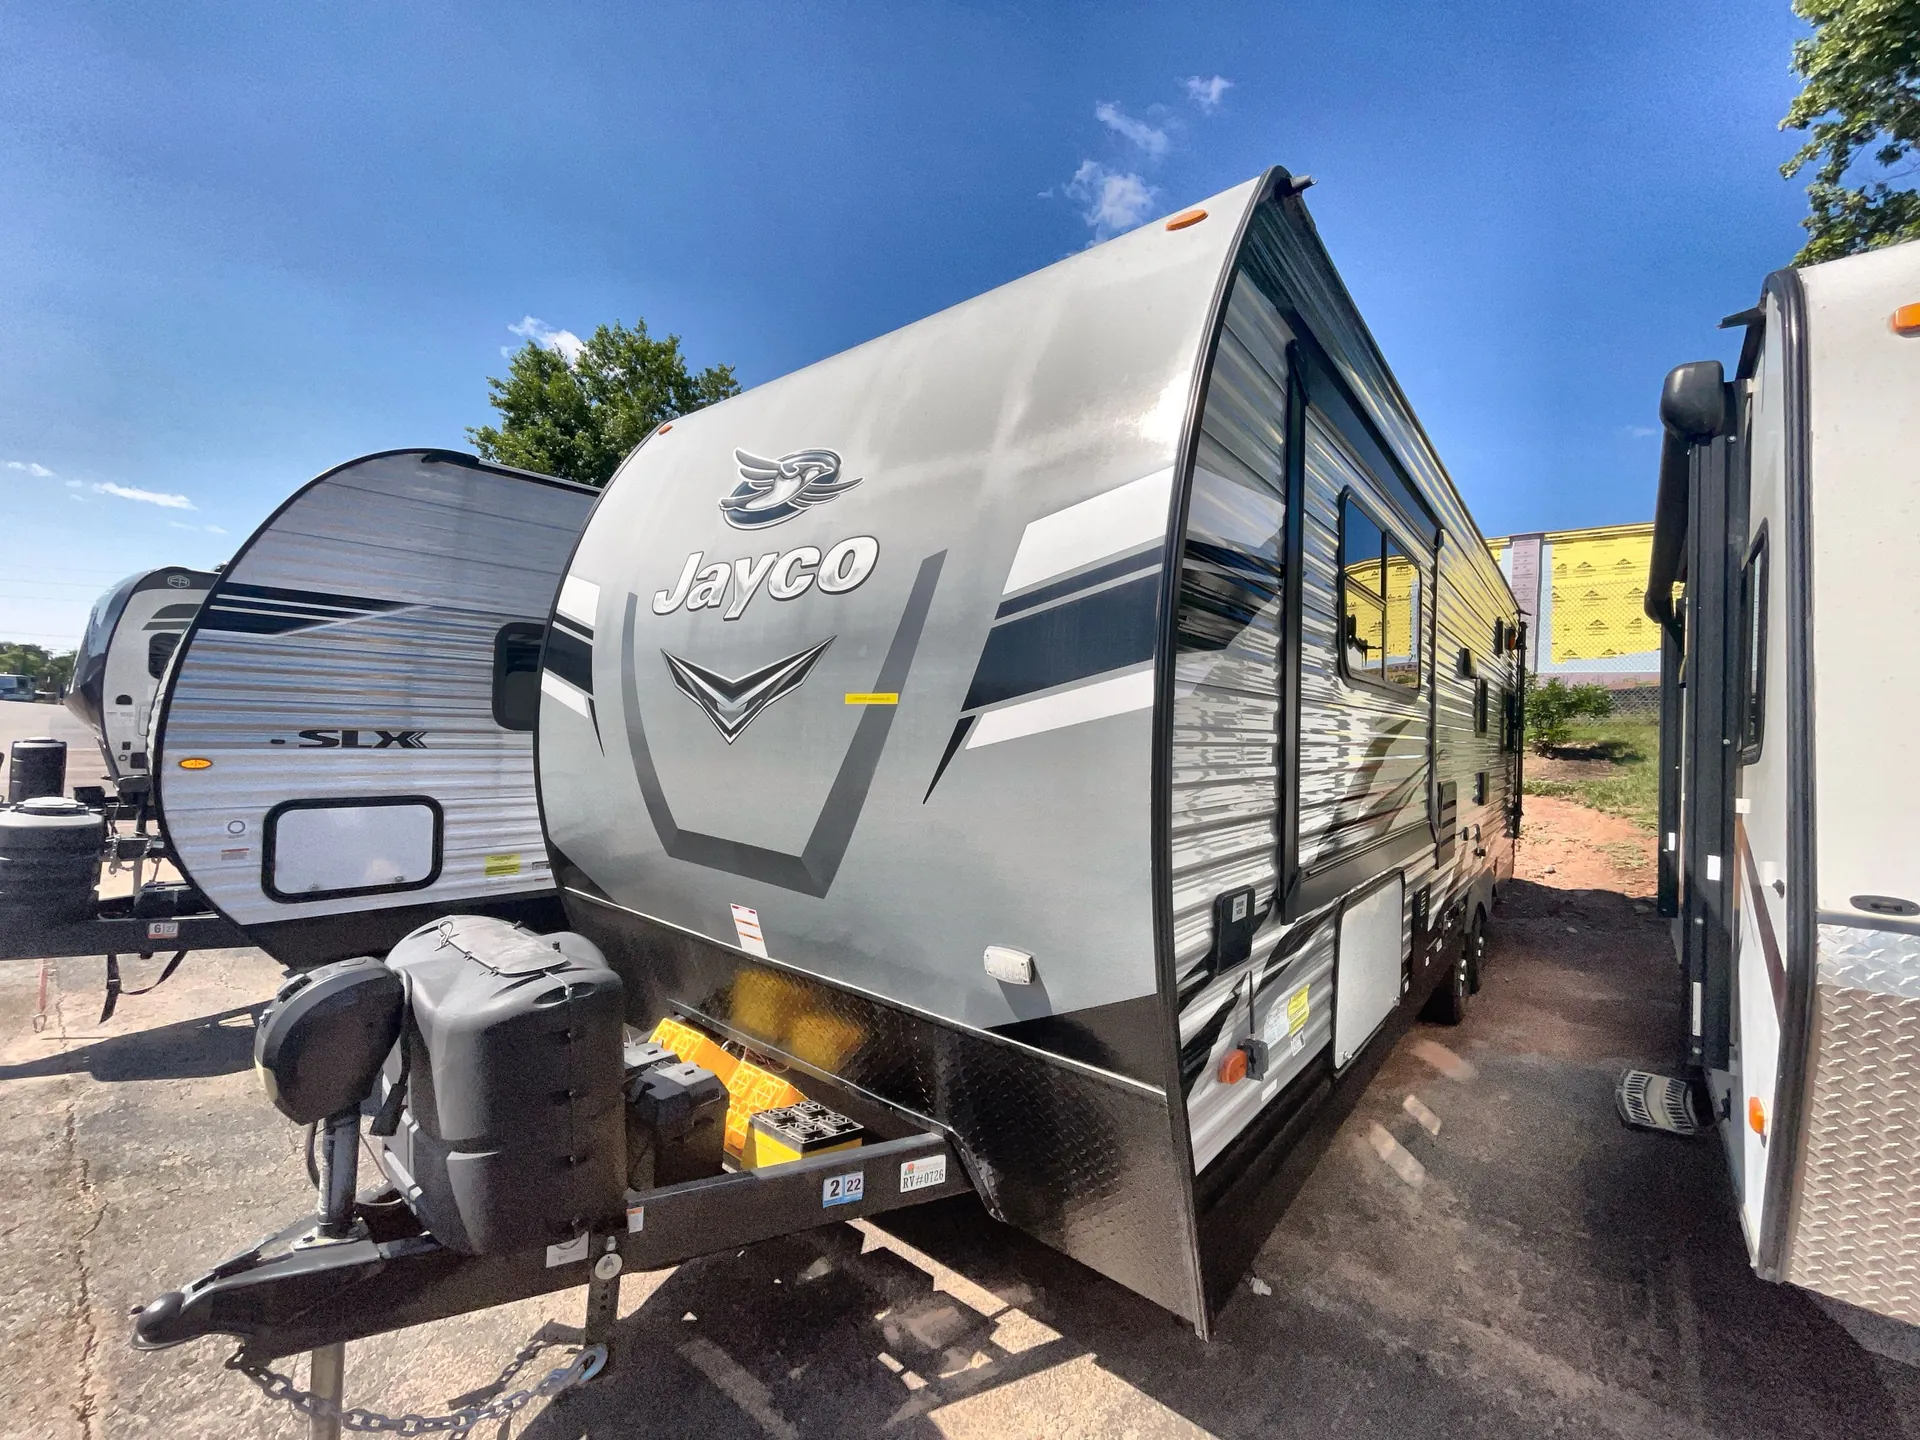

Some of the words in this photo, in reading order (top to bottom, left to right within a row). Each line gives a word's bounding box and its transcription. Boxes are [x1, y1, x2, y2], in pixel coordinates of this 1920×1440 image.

[652, 535, 880, 621] Jayco
[298, 729, 428, 749] SLX
[154, 924, 161, 934] 6
[829, 1179, 840, 1198] 2
[846, 1178, 861, 1193] 22
[903, 1169, 944, 1189] RV#0726
